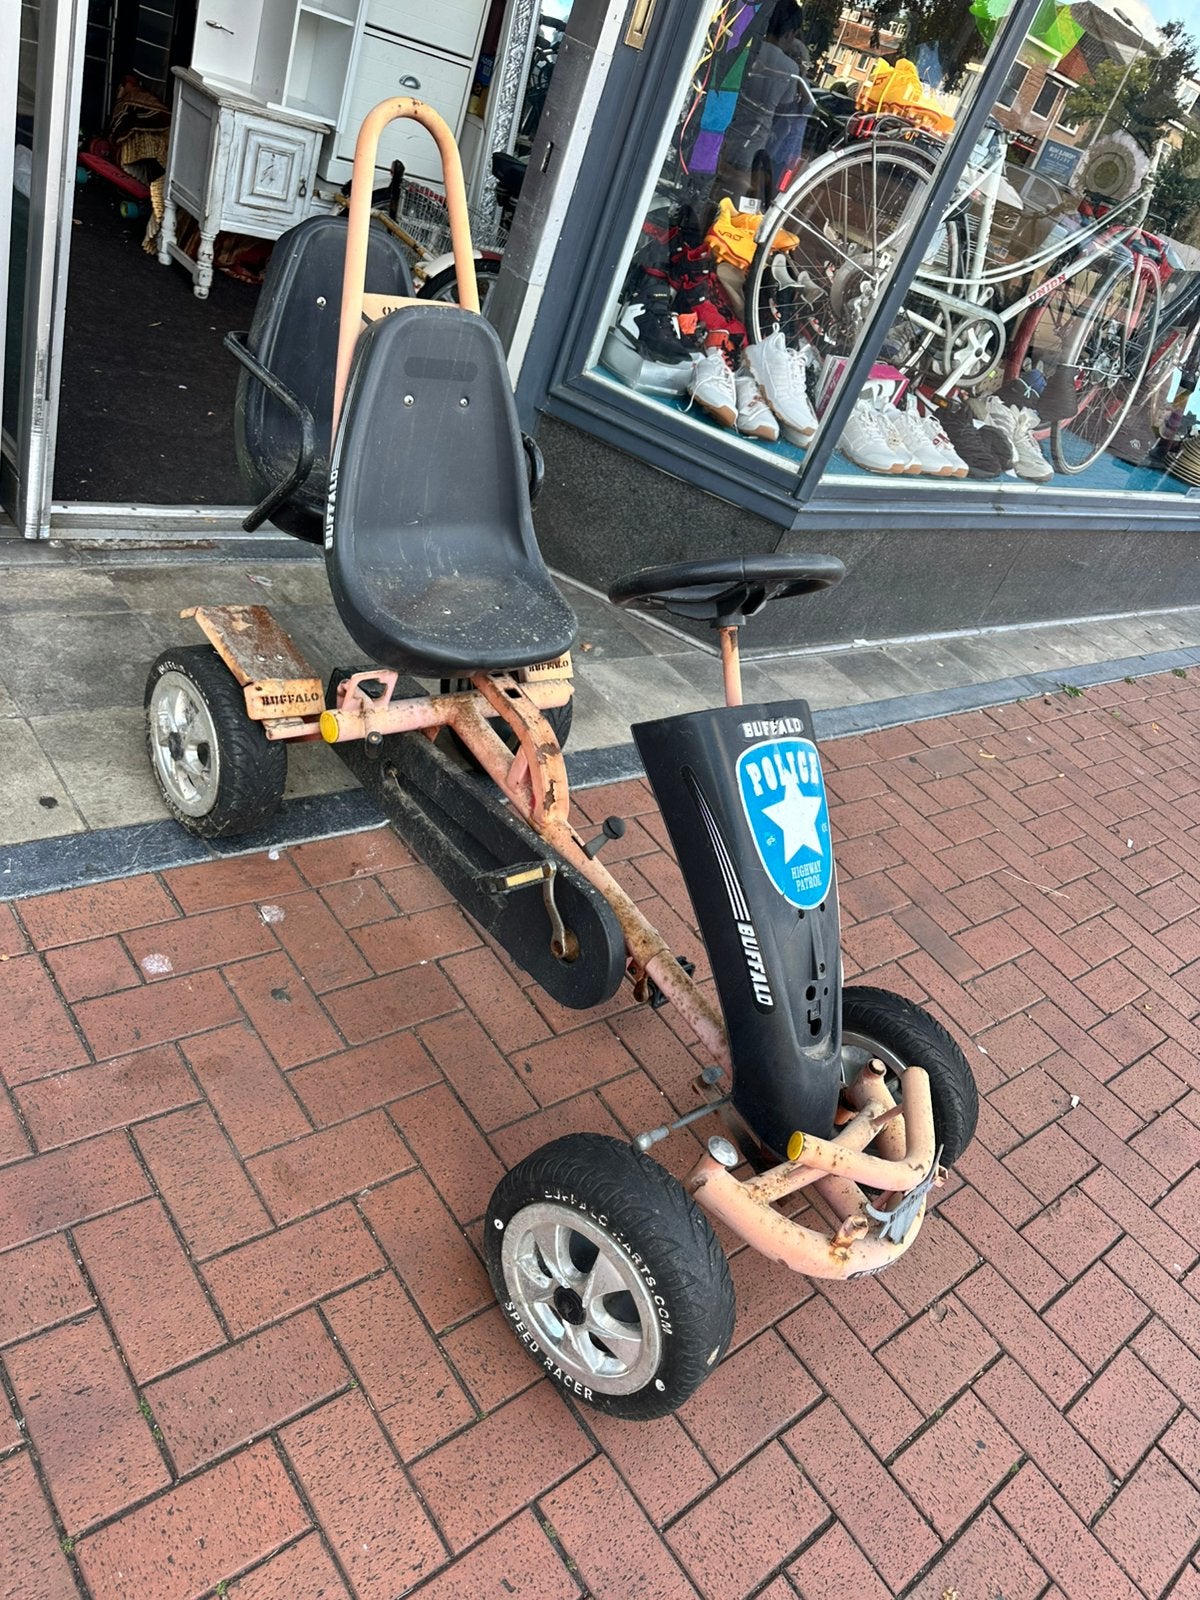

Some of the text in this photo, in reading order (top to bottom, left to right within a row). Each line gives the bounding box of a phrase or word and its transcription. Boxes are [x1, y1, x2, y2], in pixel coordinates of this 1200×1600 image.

[1028, 273, 1066, 302] UNION
[325, 469, 338, 550] BUFFALO
[261, 692, 319, 706] BUFFALO
[742, 717, 801, 738] BUFFALO
[745, 751, 820, 796] POLICE
[791, 860, 822, 880] HIGHWAY
[796, 874, 822, 893] PATROL
[737, 922, 774, 1006] BUFFALO
[505, 1301, 593, 1401] SPEED RACER
